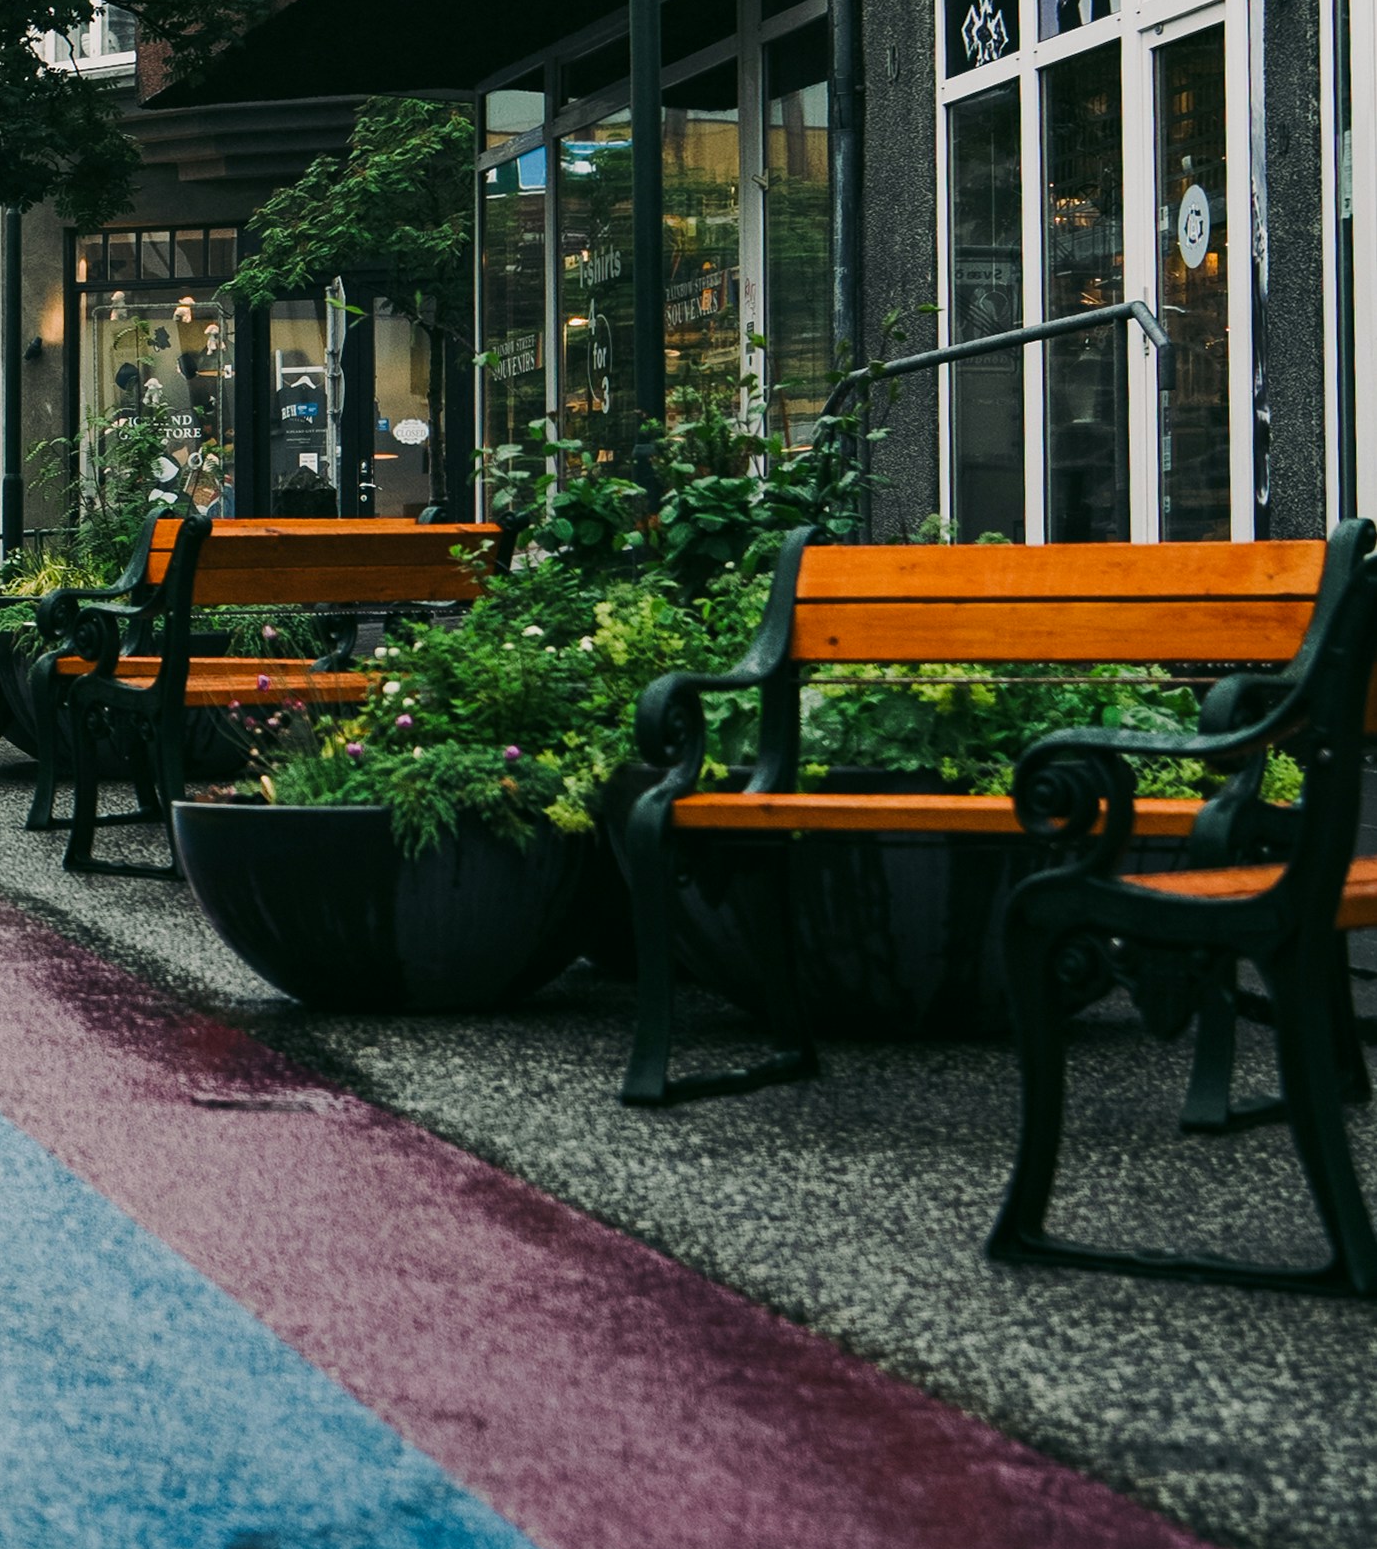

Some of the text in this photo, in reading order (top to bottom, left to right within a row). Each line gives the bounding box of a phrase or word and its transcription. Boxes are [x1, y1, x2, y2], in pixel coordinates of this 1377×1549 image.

[592, 342, 607, 371] for
[601, 376, 611, 415] 3
[395, 428, 427, 438] CLOSED
